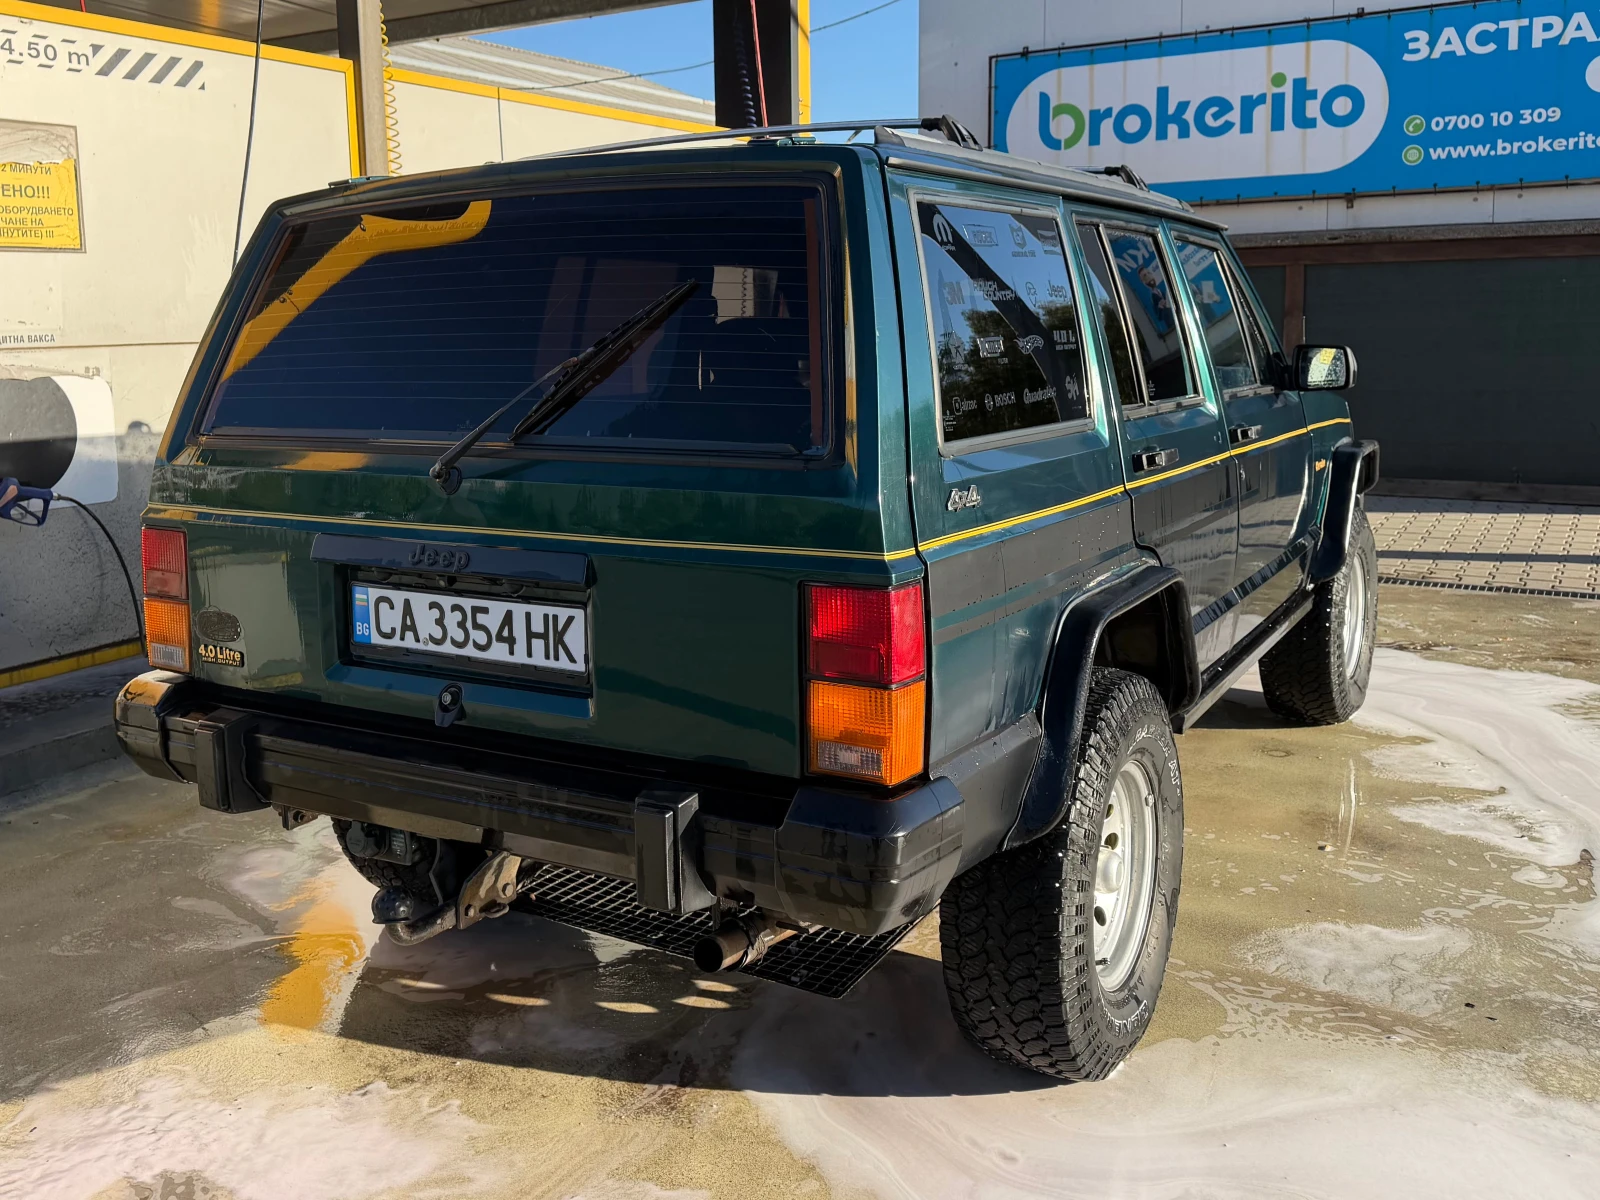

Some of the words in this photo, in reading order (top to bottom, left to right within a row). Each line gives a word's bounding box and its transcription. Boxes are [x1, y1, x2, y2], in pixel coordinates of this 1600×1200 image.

[1402, 11, 1600, 62] ЗАСТРА
[0, 38, 58, 62] 4.50
[67, 50, 90, 67] m
[1038, 72, 1366, 151] brokerito
[1431, 113, 1485, 132] 0700
[1490, 111, 1514, 127] 10
[1519, 107, 1561, 125] 309
[30, 218, 44, 227] НА
[0, 227, 43, 240] НУТИТЕ)
[0, 334, 25, 345] ИТНА
[27, 334, 56, 344] ВАКСА
[994, 391, 1017, 407] BOSCH
[408, 544, 471, 573] Jeep
[356, 621, 370, 636] BG
[428, 600, 516, 656] 3354
[198, 644, 216, 658] 4.0
[216, 646, 241, 662] Litre
